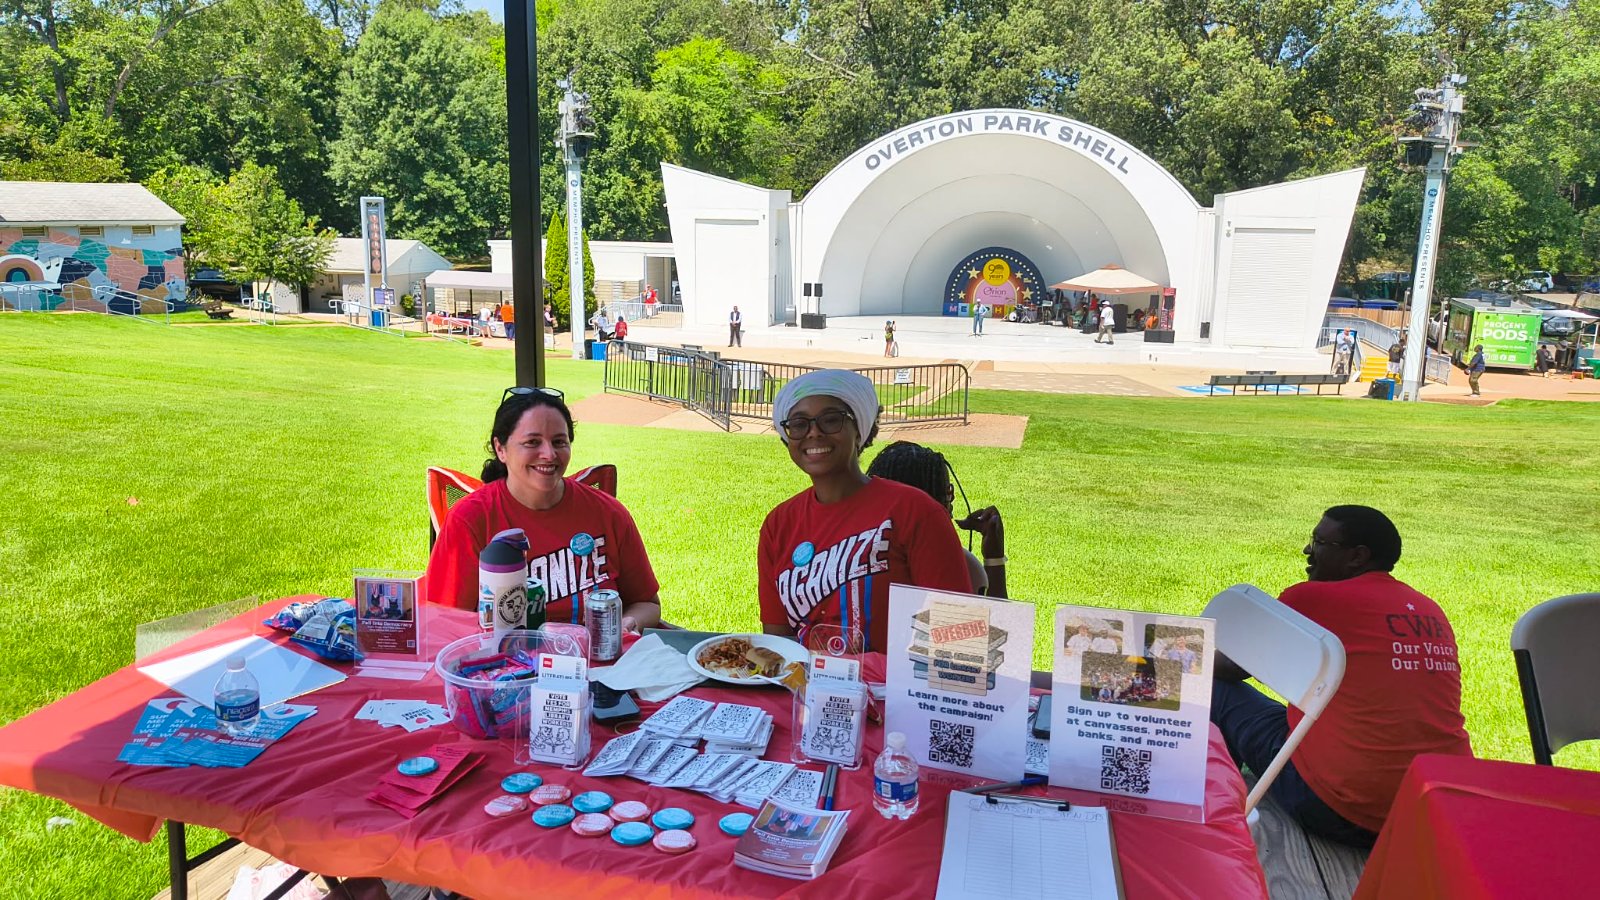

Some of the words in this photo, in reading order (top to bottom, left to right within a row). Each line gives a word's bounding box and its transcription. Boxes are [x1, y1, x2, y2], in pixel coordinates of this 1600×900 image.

[865, 117, 974, 171] OVERTON
[984, 115, 1051, 137] PARK
[1057, 125, 1130, 175] SHELL
[1419, 243, 1430, 290] PRESENTS
[1484, 321, 1527, 329] PROGENY
[1482, 328, 1528, 341] PODS
[934, 620, 986, 643] OVERDUE
[1392, 642, 1420, 655] Our
[1423, 642, 1454, 656] Voice
[934, 659, 949, 668] FOR
[950, 661, 982, 673] LIBRARY
[1391, 658, 1420, 670] Our
[1424, 658, 1457, 671] Union
[938, 671, 976, 683] WORKERS
[908, 689, 938, 701] Learn
[942, 696, 968, 706] more
[973, 701, 1005, 712] about
[545, 712, 570, 720] LIBRARY
[824, 714, 851, 722] LIBRARY
[918, 702, 936, 711] the
[940, 706, 993, 721] campaign!
[1067, 705, 1092, 716] Sign
[1097, 710, 1111, 718] up
[1117, 711, 1129, 720] to
[1135, 714, 1192, 728] volunteer
[1066, 717, 1079, 725] at
[1084, 719, 1150, 735] canvasses,
[1155, 728, 1192, 739] phone
[1077, 729, 1115, 741] banks,
[1120, 734, 1142, 744] and
[1147, 738, 1178, 749] more!
